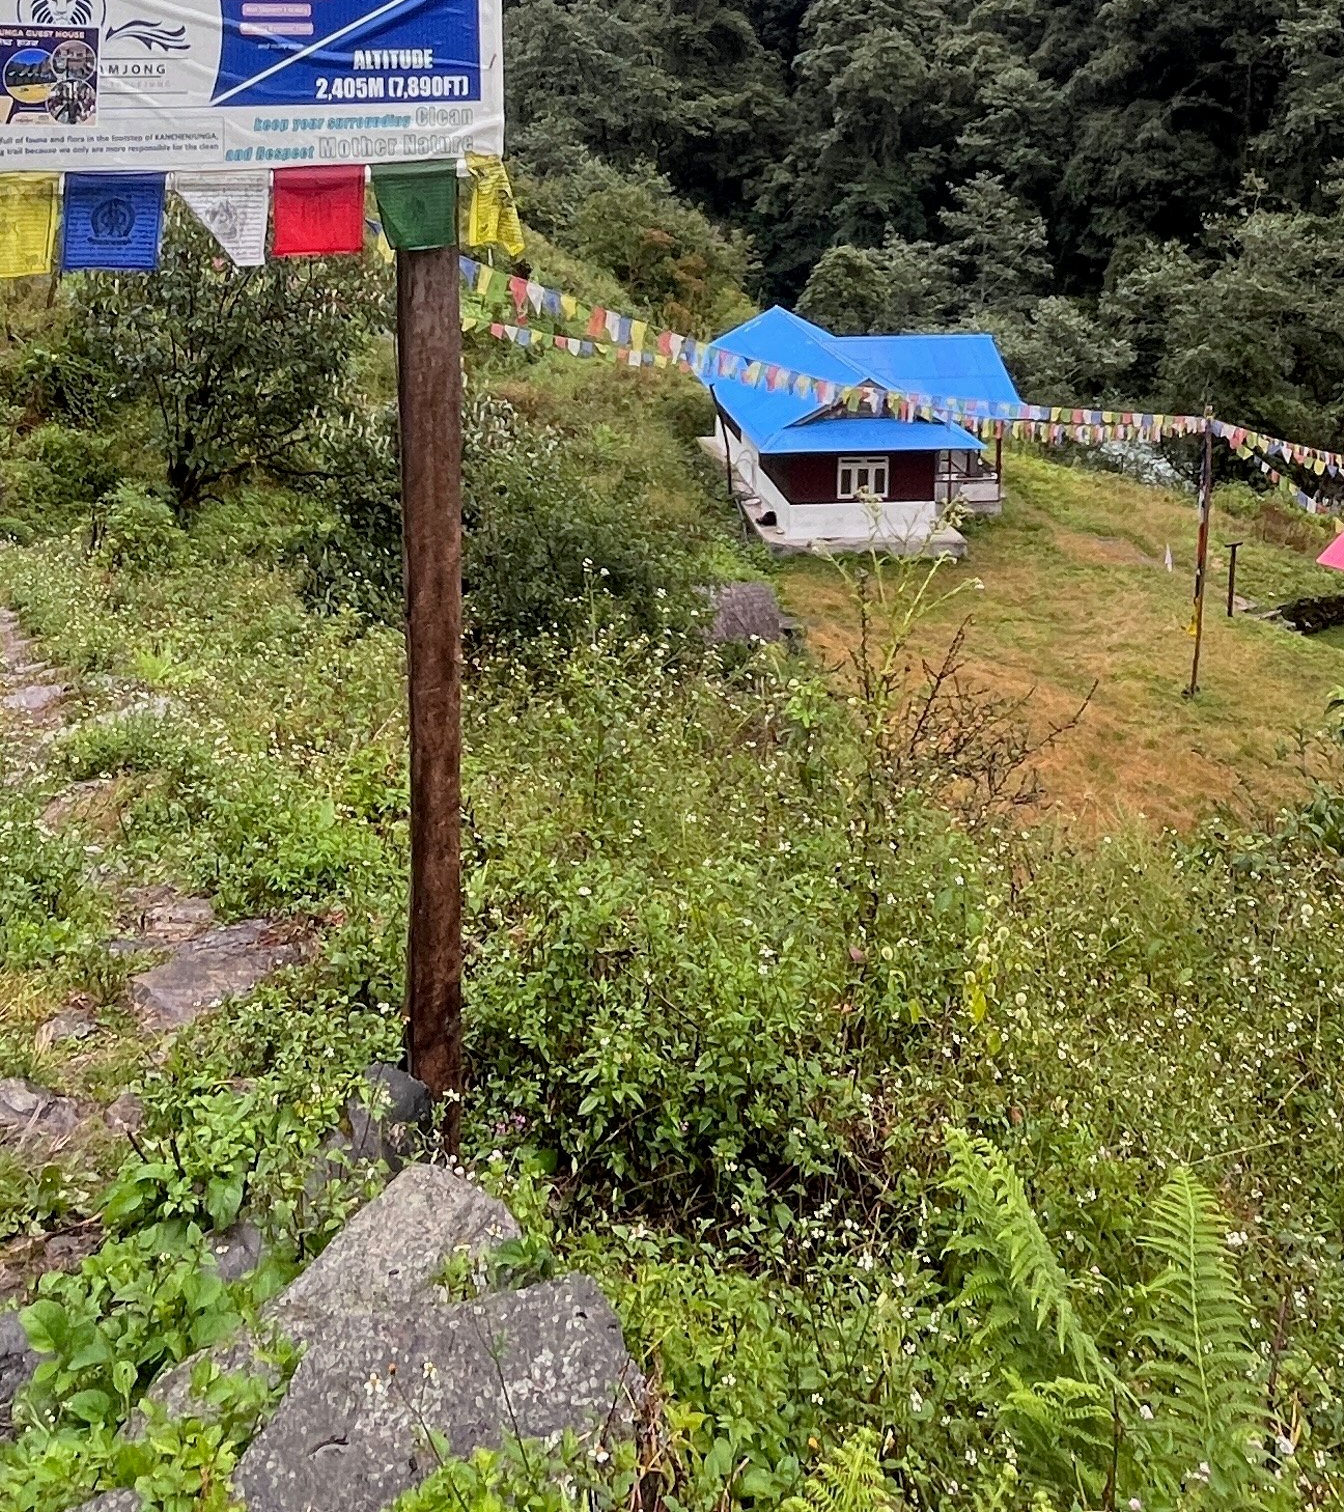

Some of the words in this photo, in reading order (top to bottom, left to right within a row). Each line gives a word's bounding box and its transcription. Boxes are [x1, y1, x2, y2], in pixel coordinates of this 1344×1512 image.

[353, 49, 433, 70] ALTITUDE
[316, 77, 384, 100] 2,405M
[388, 76, 469, 98] (7,890FT)
[254, 117, 289, 132] keep
[291, 117, 325, 131] your
[327, 114, 411, 129] surrounding
[415, 107, 473, 127] Clean
[0, 137, 13, 145] full
[73, 146, 88, 154] only
[225, 147, 253, 161] and
[255, 146, 315, 161] Respect
[318, 135, 397, 158] Mother
[403, 135, 474, 154] Nature
